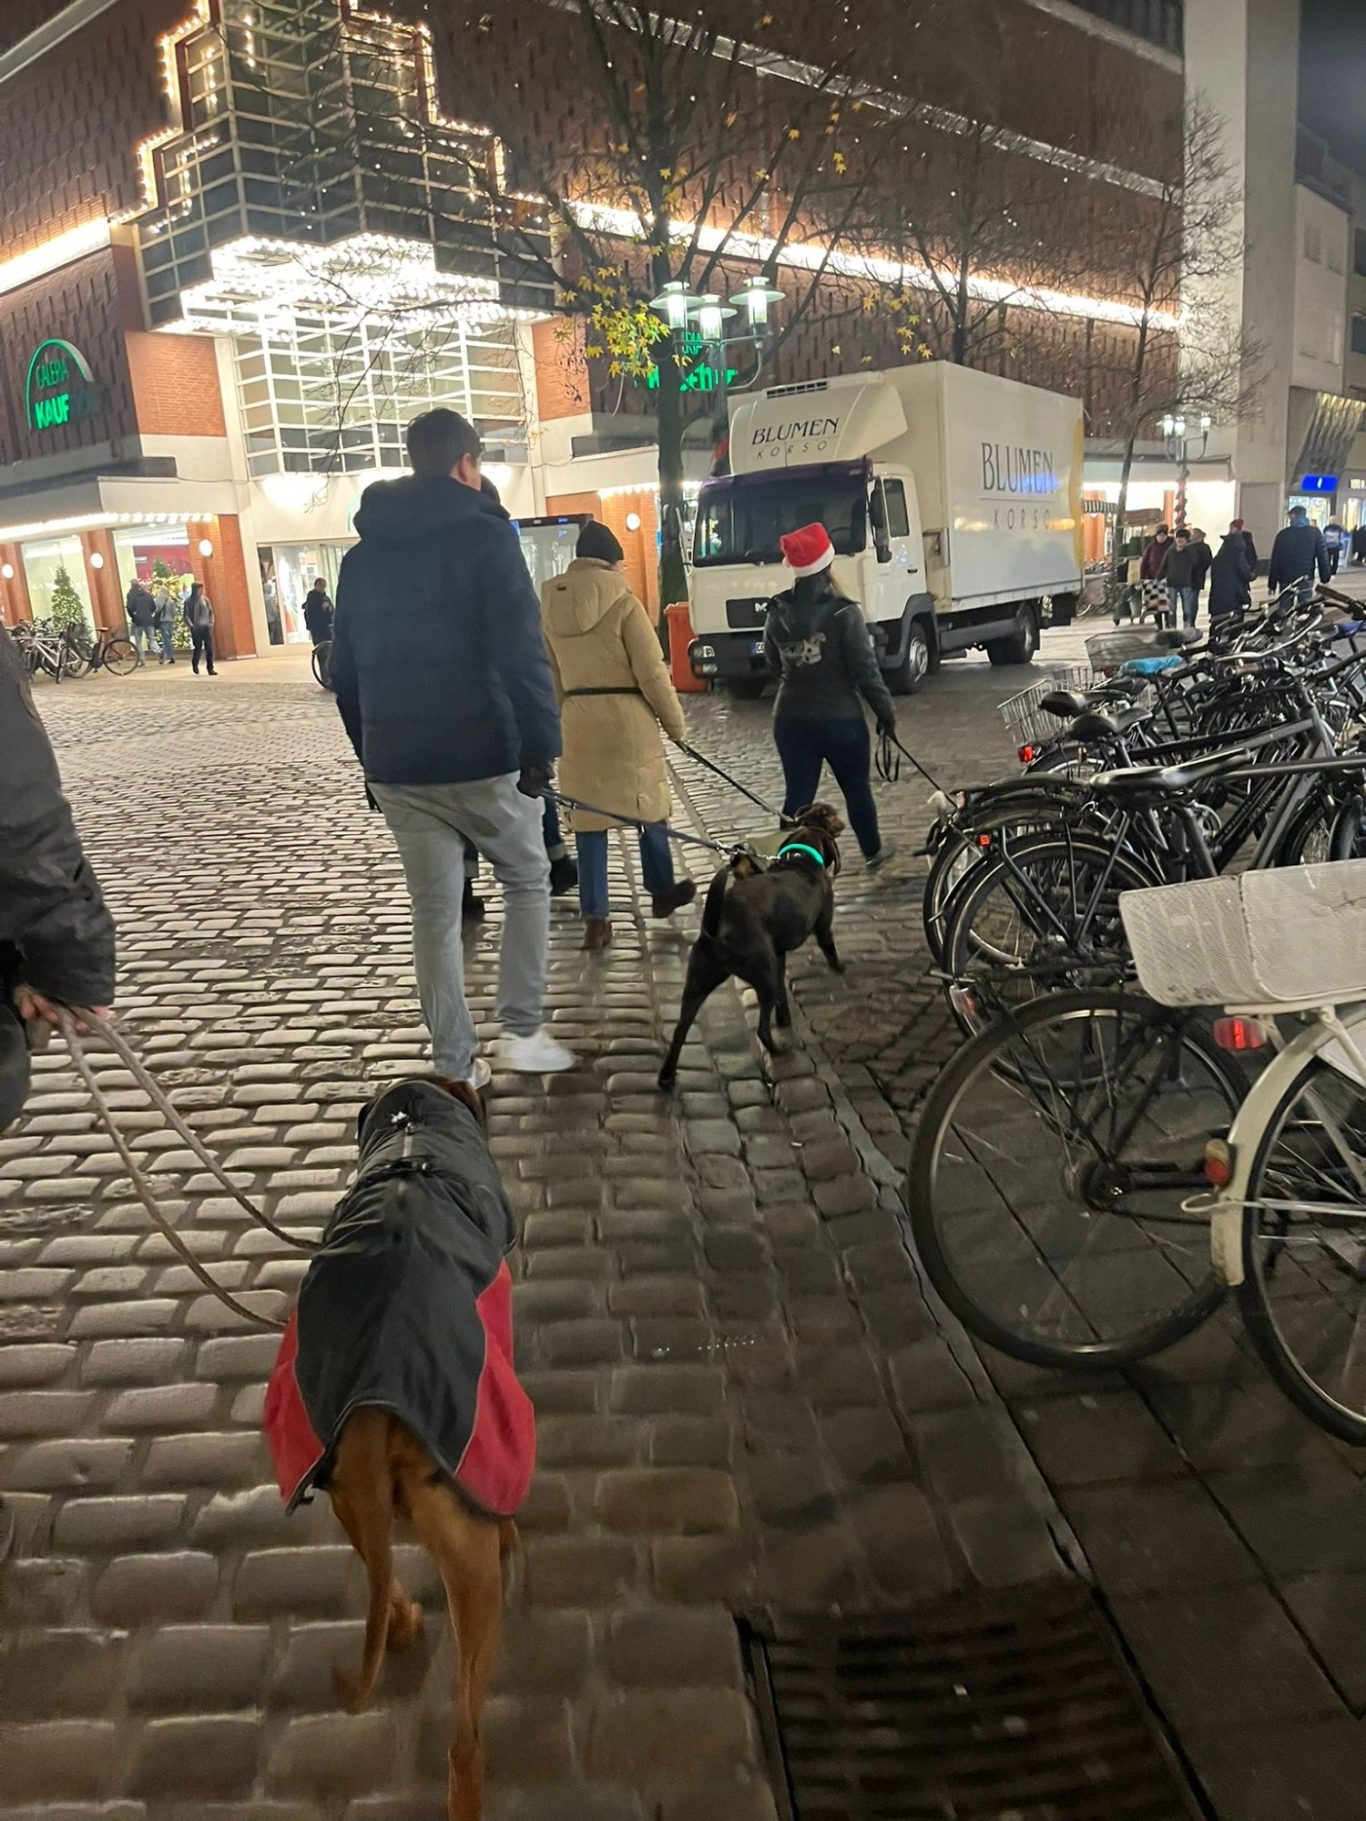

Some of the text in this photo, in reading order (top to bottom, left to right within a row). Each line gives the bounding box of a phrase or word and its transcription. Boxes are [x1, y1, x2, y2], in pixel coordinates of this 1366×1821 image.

[752, 417, 840, 446] BLUMEN
[756, 440, 828, 460] KORSO
[981, 442, 1055, 495] BLUMEN
[993, 507, 1051, 531] KORSO
